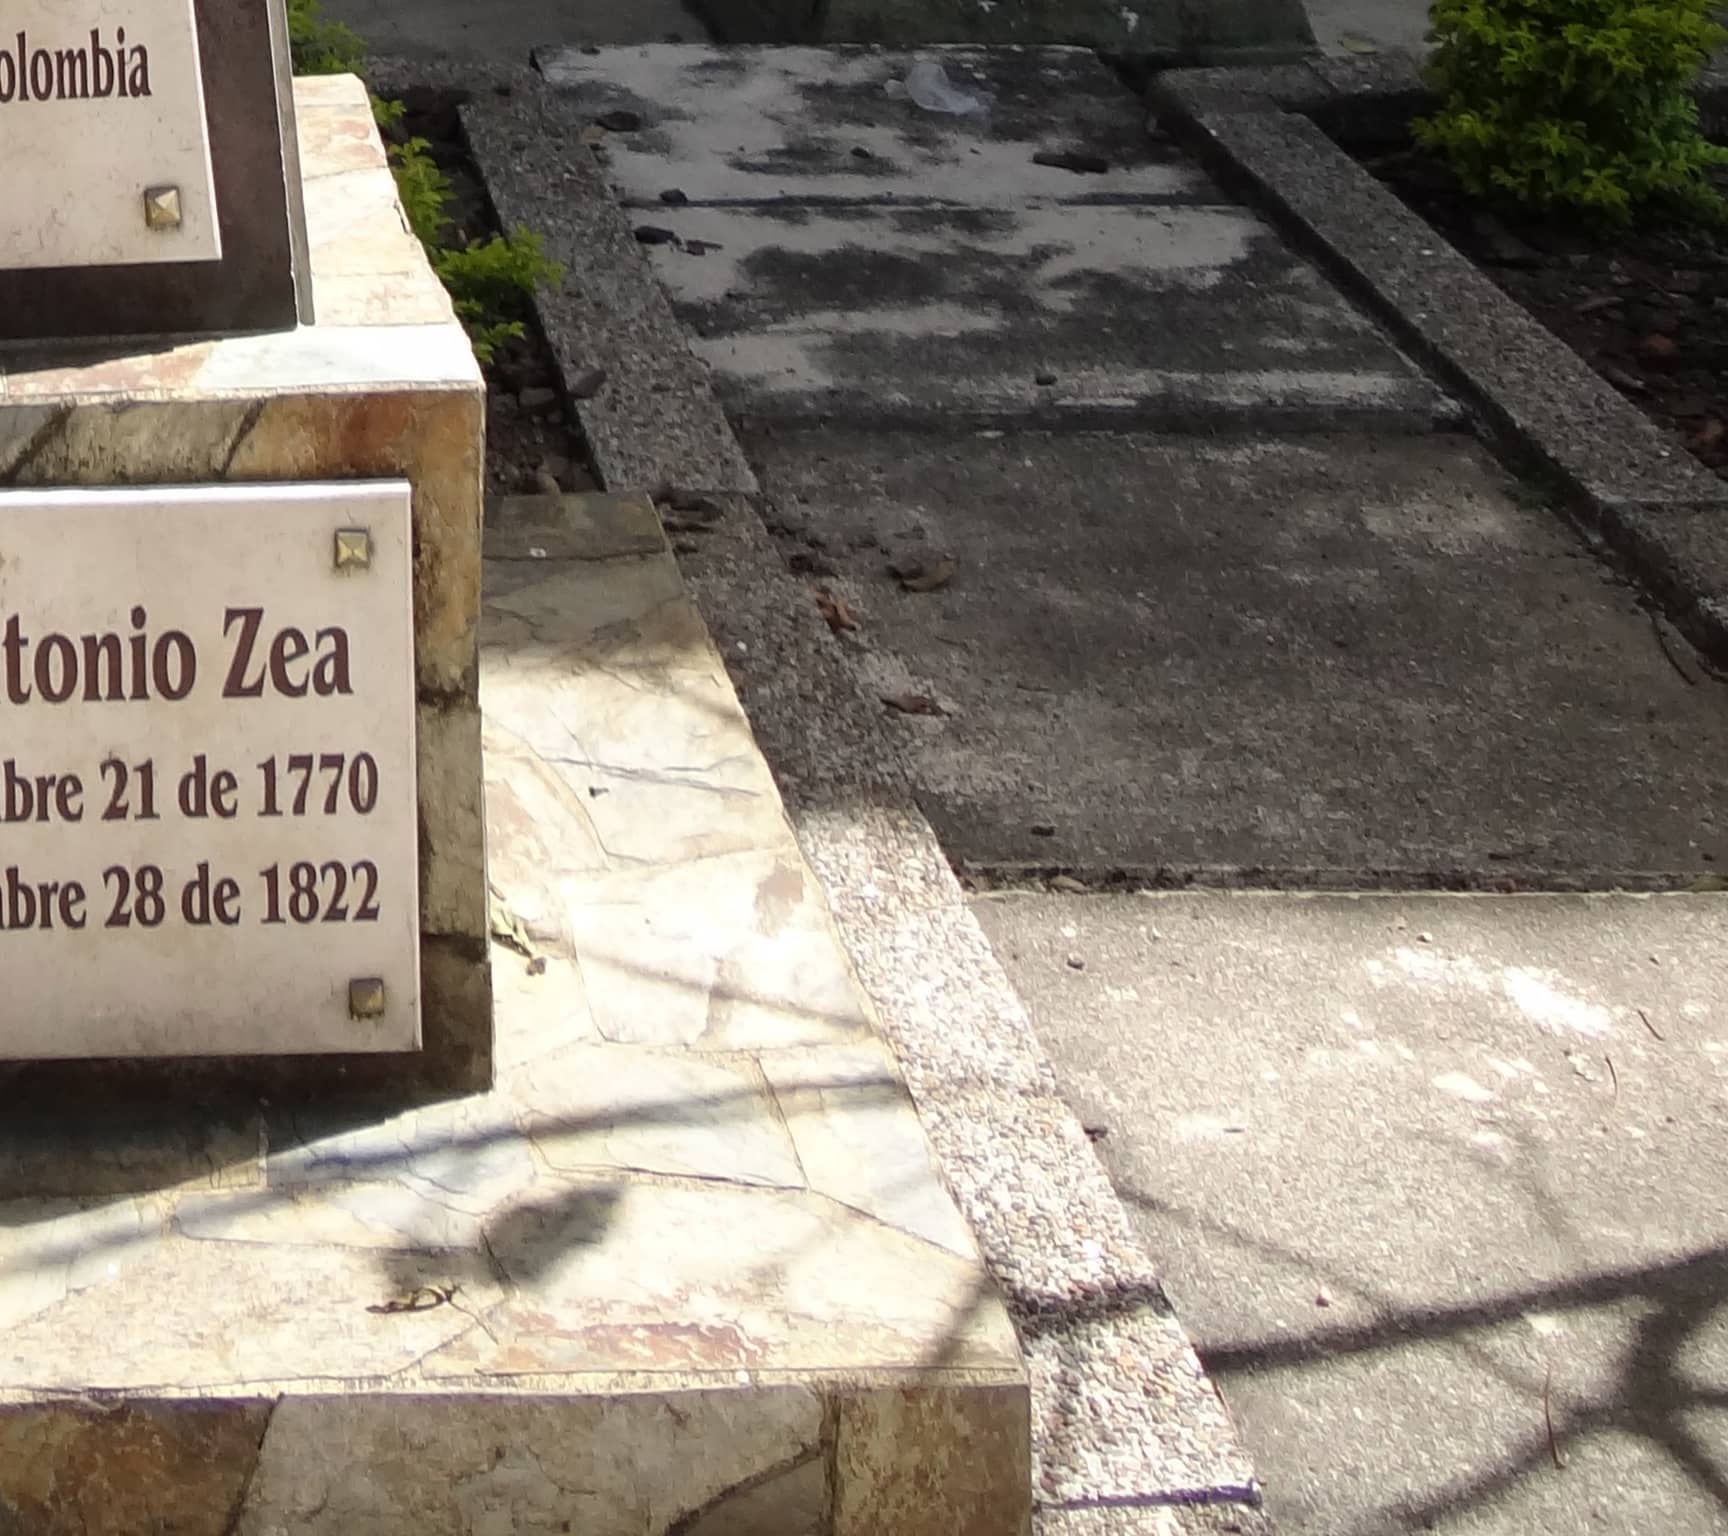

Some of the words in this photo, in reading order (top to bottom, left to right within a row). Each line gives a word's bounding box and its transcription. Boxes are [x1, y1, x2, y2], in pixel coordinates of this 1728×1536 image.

[222, 607, 353, 698] Zea
[99, 757, 161, 821] 21
[178, 754, 238, 819] de
[257, 752, 378, 817] 1770
[102, 864, 166, 929] 28
[181, 861, 241, 926] de
[259, 860, 380, 924] 1822
